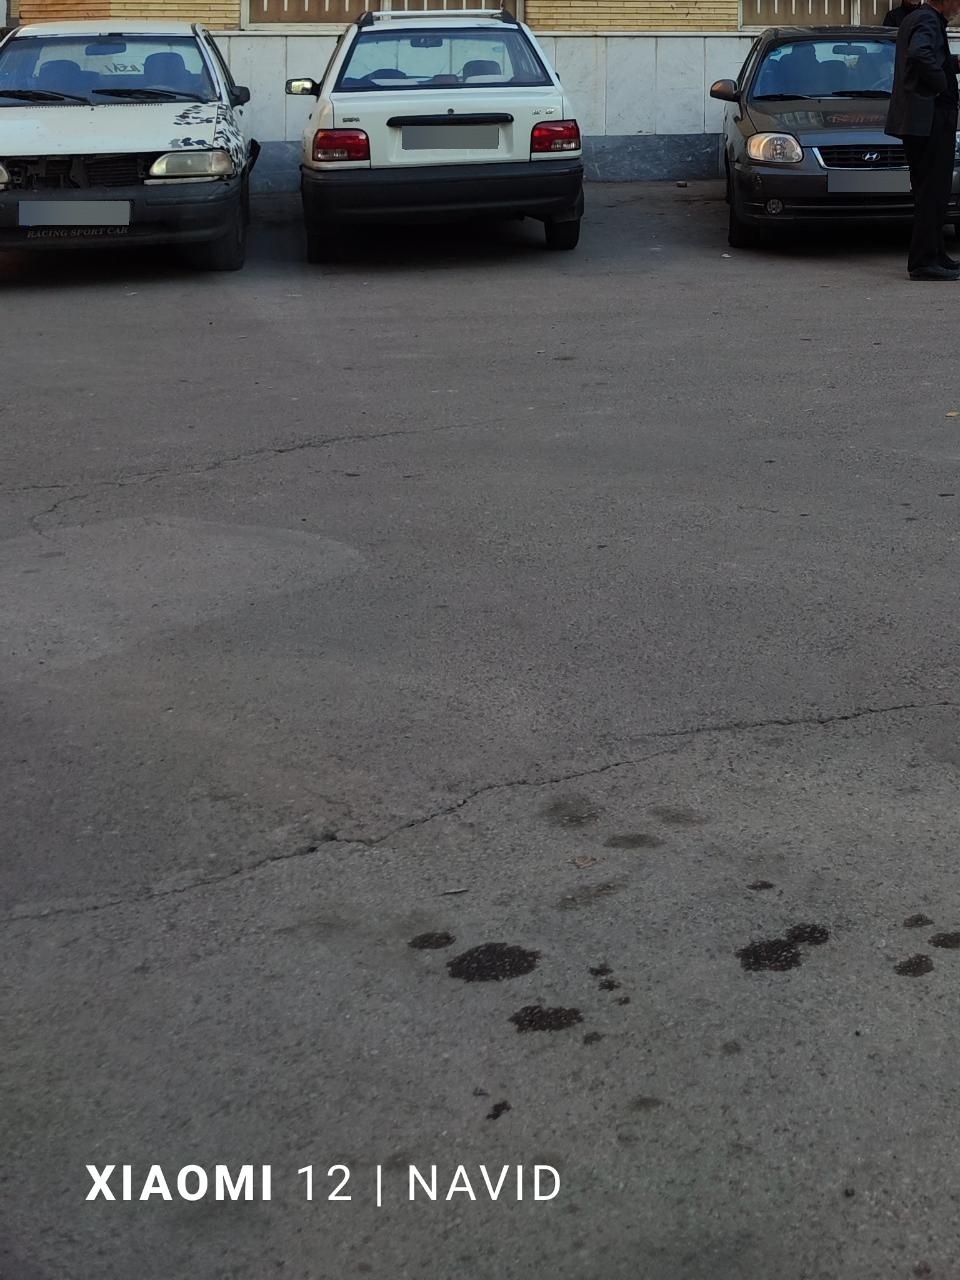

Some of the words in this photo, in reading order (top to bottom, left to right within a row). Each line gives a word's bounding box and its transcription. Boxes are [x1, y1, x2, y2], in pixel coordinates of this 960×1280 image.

[27, 228, 68, 239] RACING
[70, 227, 105, 237] SPORT
[107, 225, 129, 235] CAR
